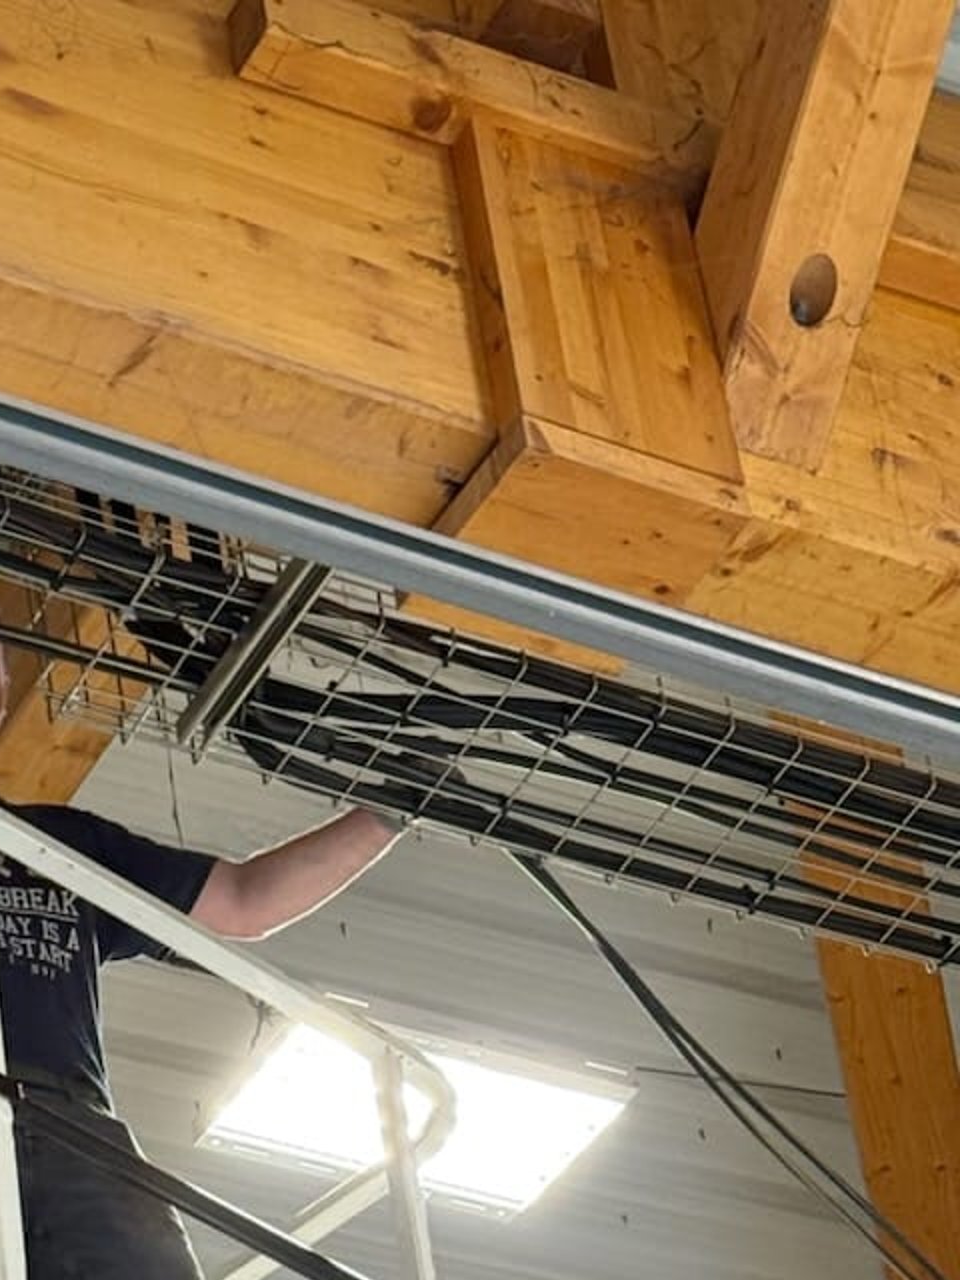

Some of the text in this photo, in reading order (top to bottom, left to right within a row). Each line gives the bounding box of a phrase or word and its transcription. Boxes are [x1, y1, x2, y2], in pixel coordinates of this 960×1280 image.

[41, 919, 60, 943] IS
[67, 927, 80, 951] A
[8, 936, 73, 973] START
